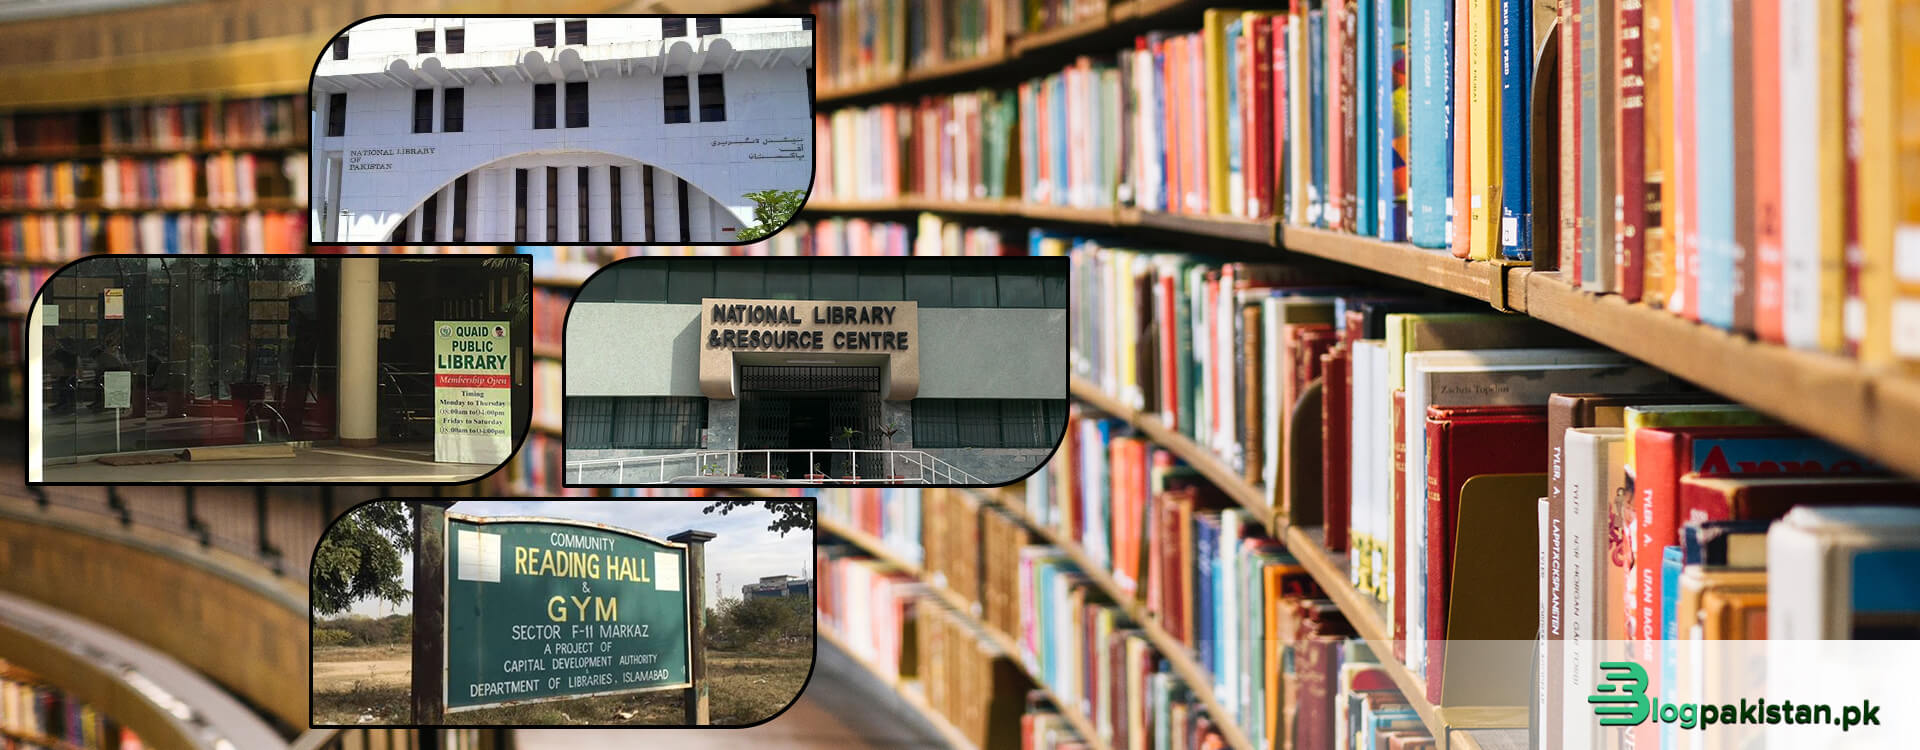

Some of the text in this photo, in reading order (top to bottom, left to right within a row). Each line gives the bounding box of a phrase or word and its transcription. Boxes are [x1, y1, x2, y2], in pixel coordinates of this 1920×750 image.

[350, 147, 436, 157] NATIONAL LIBRARY
[350, 156, 362, 164] OF
[349, 163, 393, 171] PAKISTAN
[713, 303, 896, 325] NATIONAL LIBRARY
[456, 326, 489, 338] QUAID
[452, 340, 493, 353] PUBLIC
[833, 330, 909, 350] CENTRE
[438, 354, 508, 370] LIBRARY
[439, 375, 507, 388] Membership Open
[461, 390, 485, 398] Timing
[440, 399, 465, 408] Monday
[443, 417, 464, 426] Friday
[473, 418, 503, 426] Saturday
[550, 532, 616, 552] COMMUNITY
[515, 546, 651, 583] READING HALL
[582, 581, 592, 594] &
[547, 595, 618, 622] GYM
[511, 624, 649, 640] SECTOR F-11 MARKAZ
[544, 641, 613, 655] A PROJECT OF
[503, 654, 658, 674] CAPITAL DEVELOPMENT AUTHORITY
[470, 679, 540, 698] DEPARTMENT
[548, 677, 561, 690] OF
[622, 669, 669, 684] ISLAMABAD
